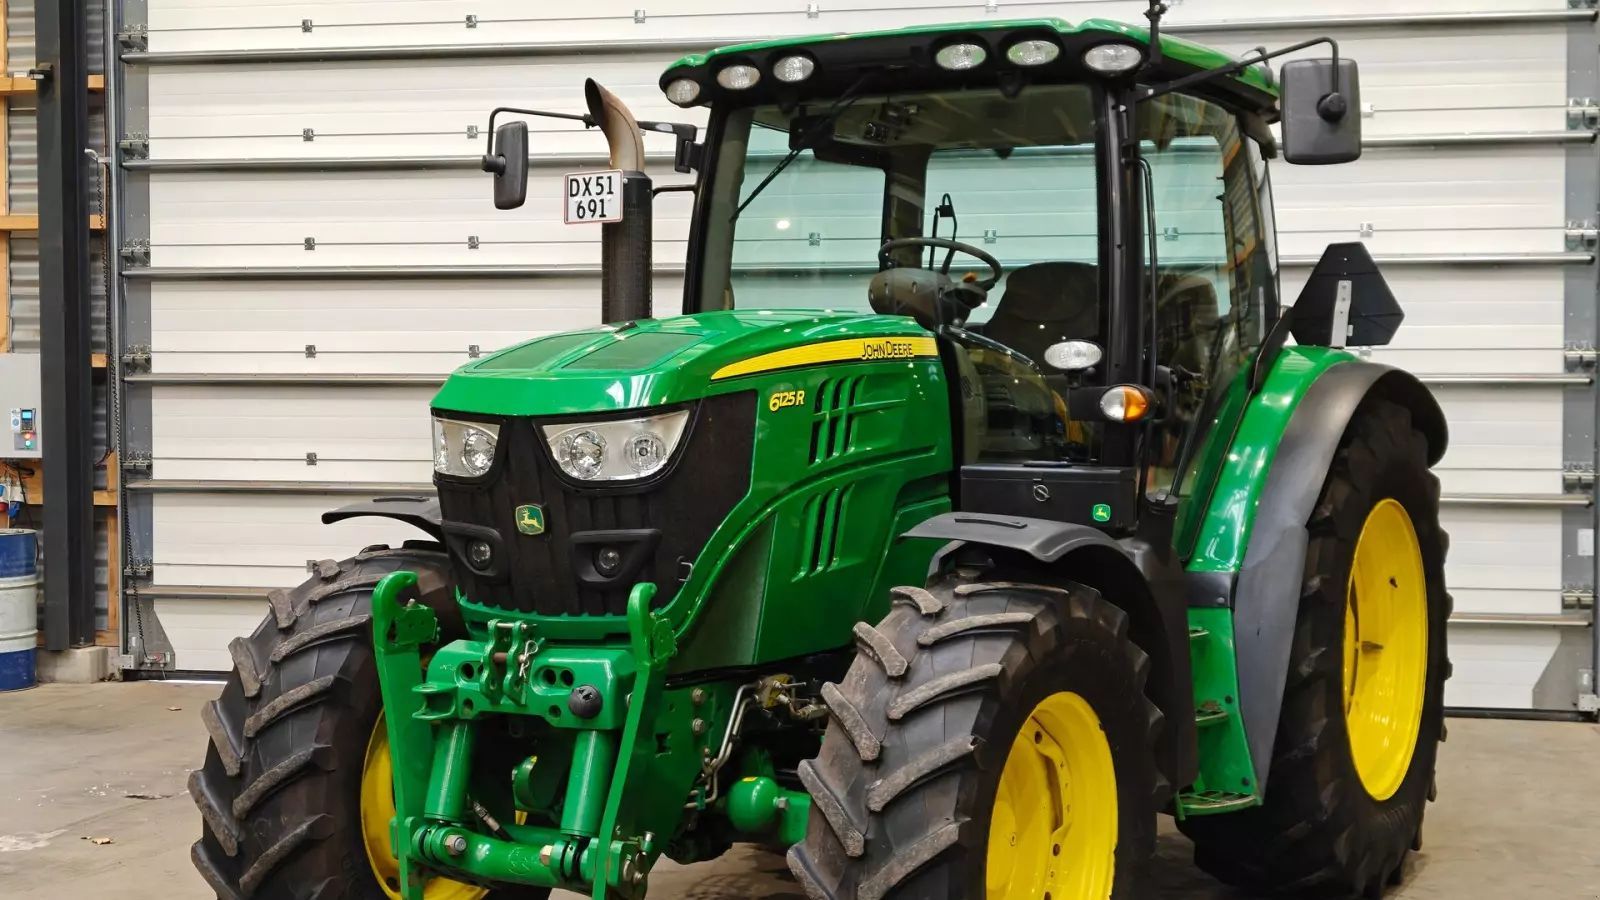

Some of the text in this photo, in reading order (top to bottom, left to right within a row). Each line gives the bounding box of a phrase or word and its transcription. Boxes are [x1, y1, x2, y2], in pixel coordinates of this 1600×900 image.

[570, 175, 614, 197] DX51
[576, 199, 606, 219] 691
[862, 341, 913, 358] JOHN DEERE
